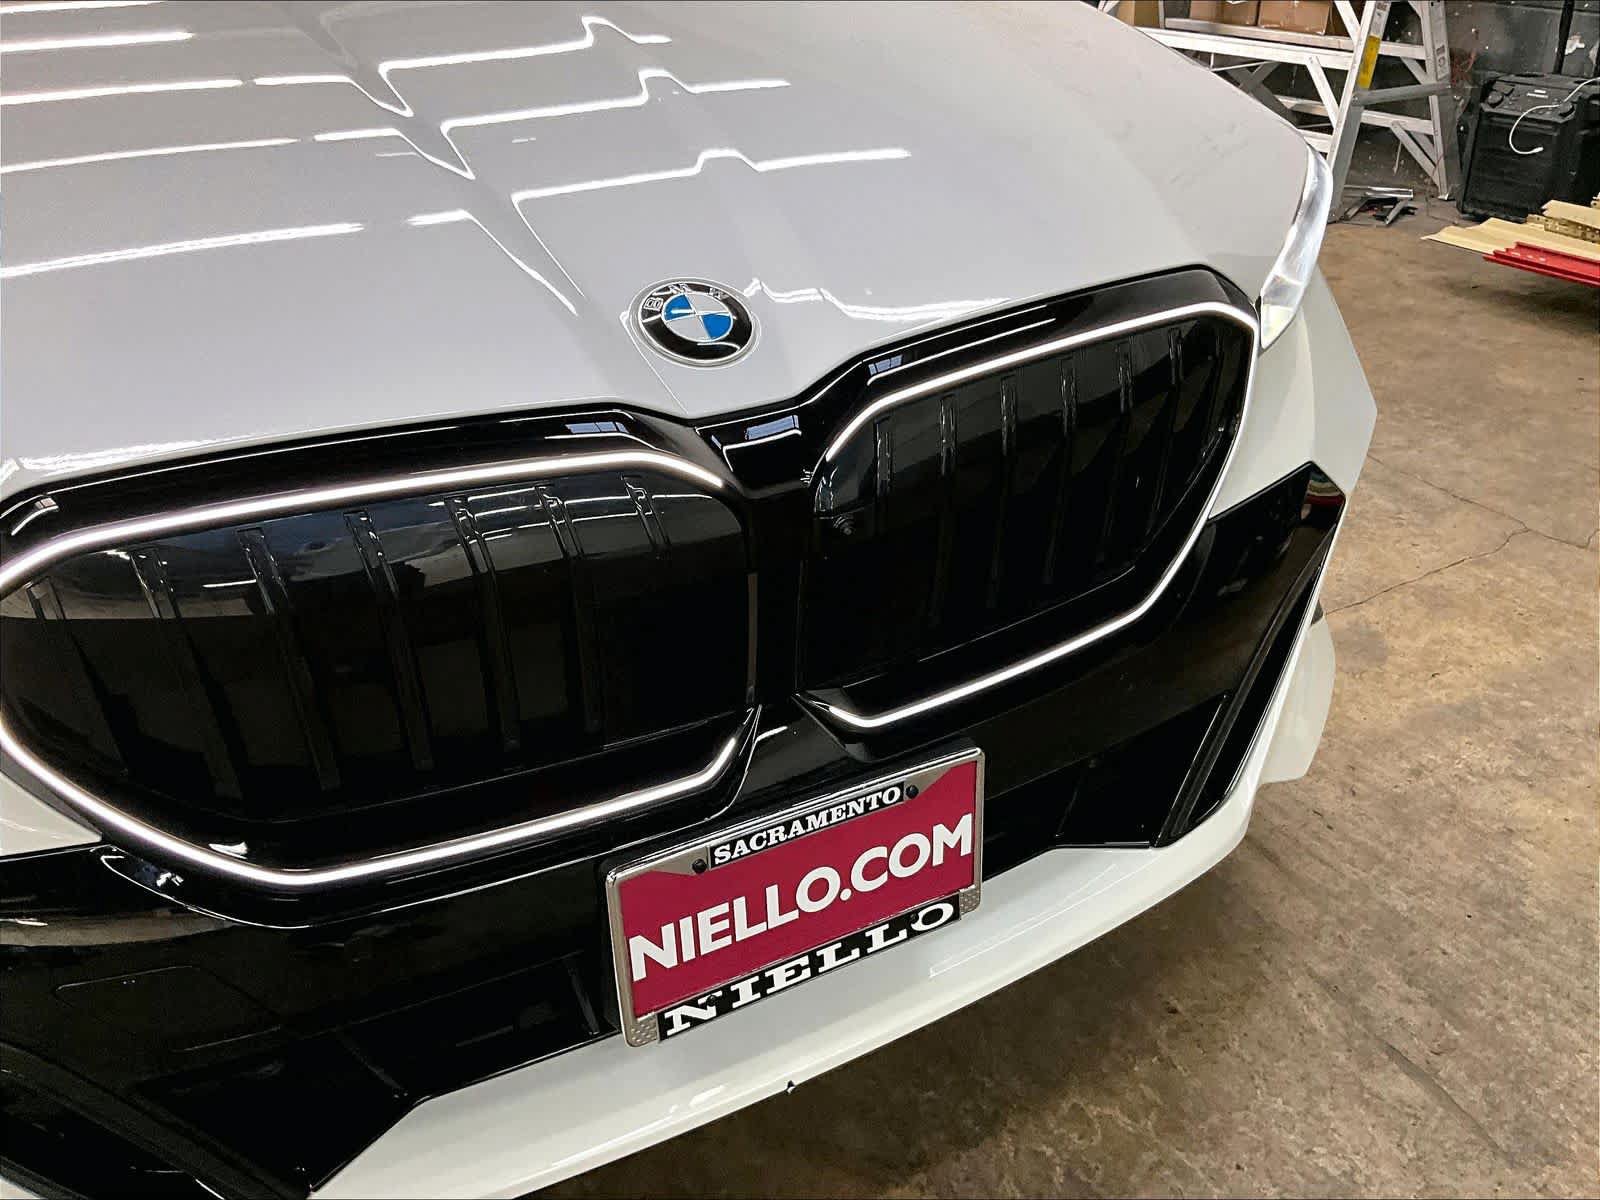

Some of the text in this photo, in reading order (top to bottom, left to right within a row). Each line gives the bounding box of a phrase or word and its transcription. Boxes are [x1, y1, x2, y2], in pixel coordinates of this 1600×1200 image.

[713, 786, 902, 865] SACRAMENTO
[628, 813, 973, 982] NIELLO.COM
[664, 902, 955, 1036] NIELLO
